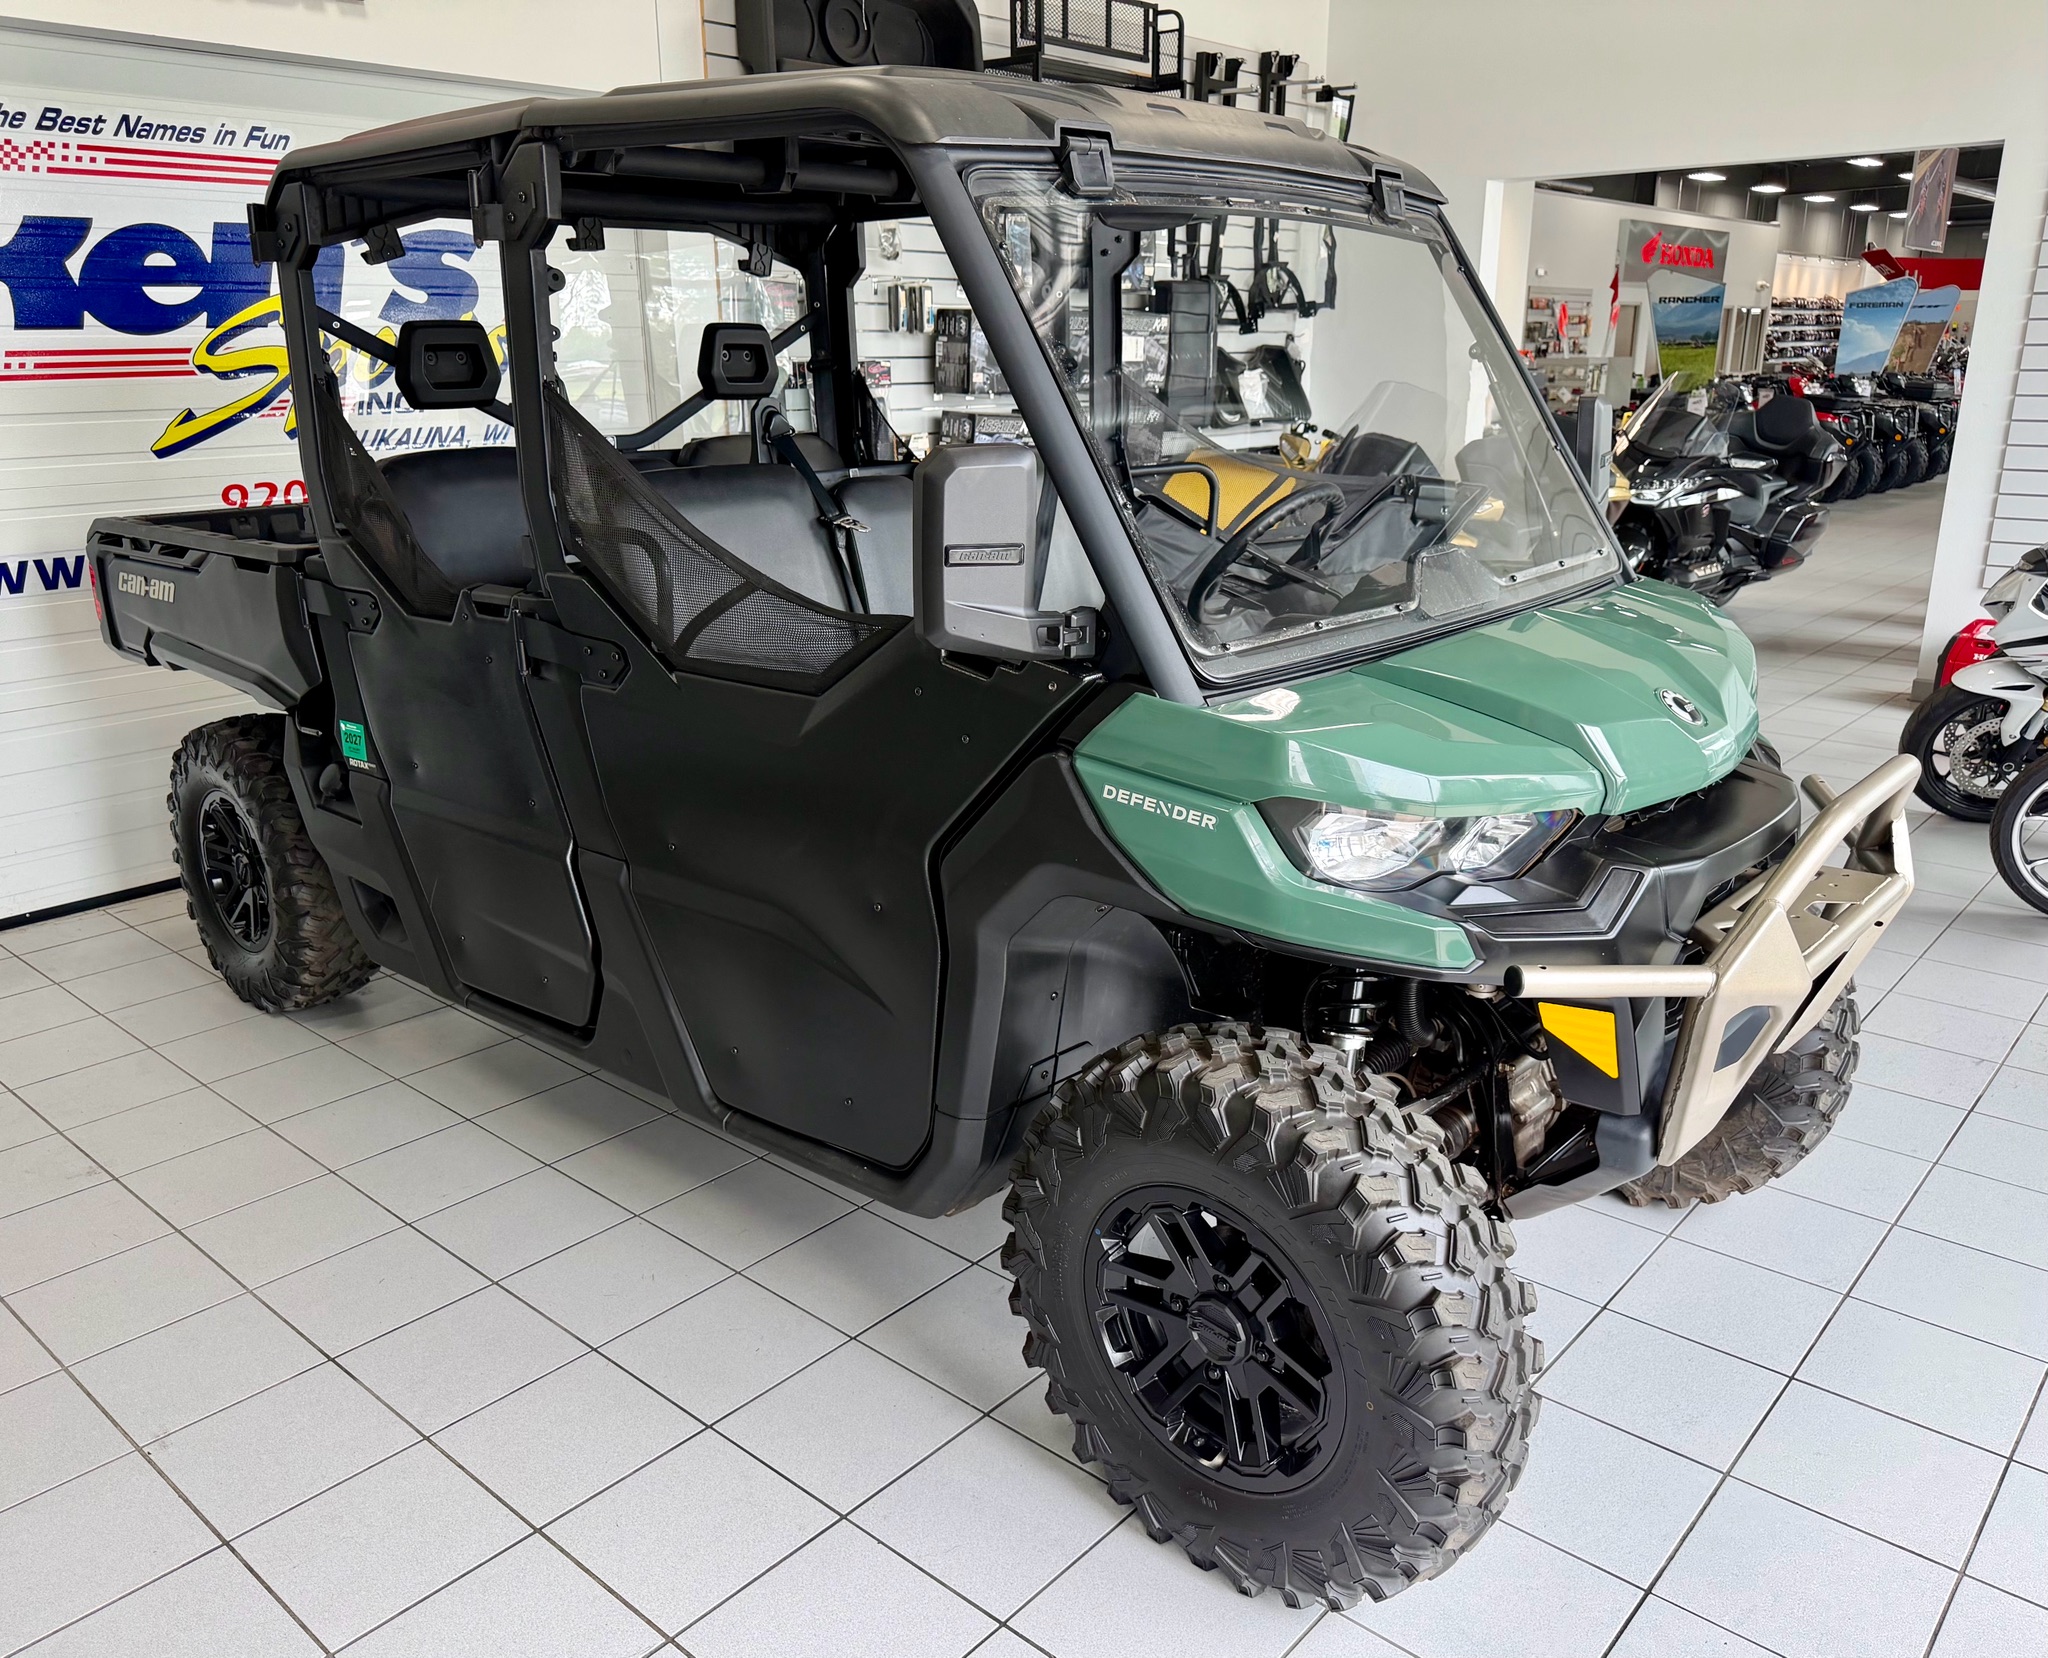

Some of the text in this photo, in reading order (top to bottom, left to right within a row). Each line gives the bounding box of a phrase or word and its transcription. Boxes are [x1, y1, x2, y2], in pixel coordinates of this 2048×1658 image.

[0, 103, 290, 150] he Best Names in Fun
[1659, 243, 1714, 269] HONDA
[1658, 296, 1720, 304] RANCHER
[1849, 301, 1904, 309] FOREMAN
[353, 423, 511, 452] UKAUNA, WI
[221, 480, 309, 509] 920
[343, 732, 361, 746] 2027
[349, 758, 369, 769] ROTAX
[1103, 784, 1217, 831] DEFENDER
